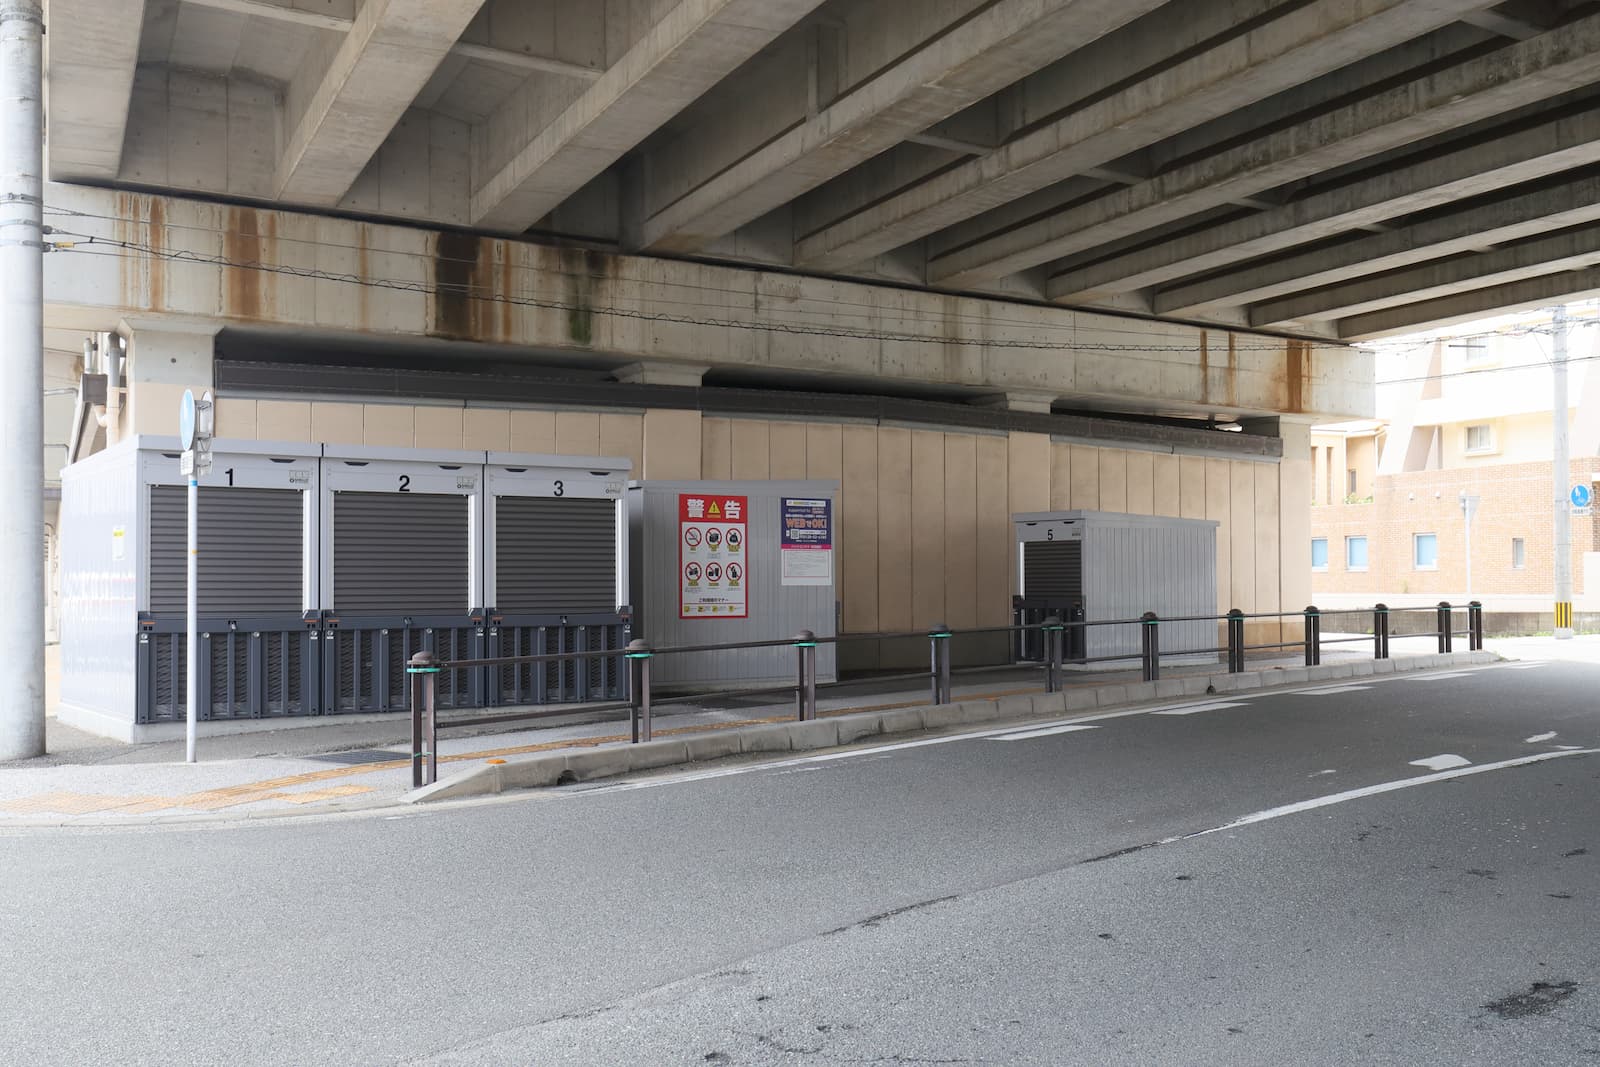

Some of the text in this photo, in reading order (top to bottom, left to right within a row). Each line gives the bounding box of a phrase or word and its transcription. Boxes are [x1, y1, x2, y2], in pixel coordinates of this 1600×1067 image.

[225, 468, 233, 486] 1
[399, 474, 410, 492] 2
[553, 480, 564, 497] 3
[687, 498, 741, 519] 警告
[1047, 529, 1054, 541] 5
